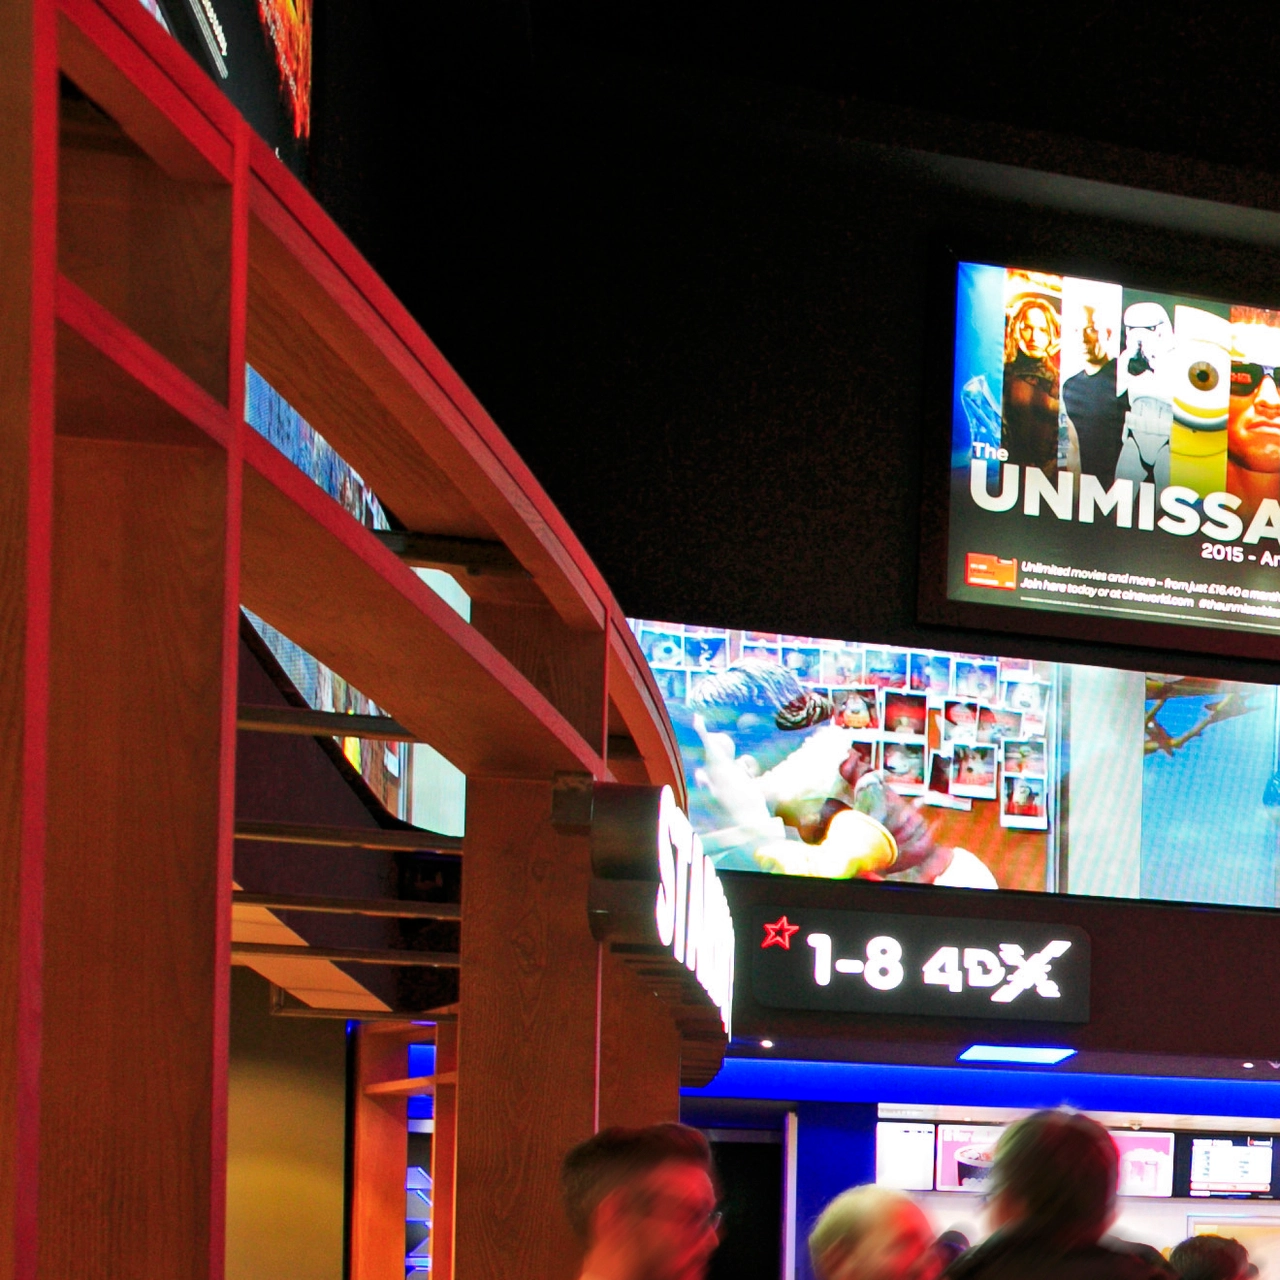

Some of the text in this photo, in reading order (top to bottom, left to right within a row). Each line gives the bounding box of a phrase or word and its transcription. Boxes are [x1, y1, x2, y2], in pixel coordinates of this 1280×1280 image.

[972, 441, 1008, 462] The
[1201, 543, 1243, 562] 2015
[1020, 578, 1042, 590] Join
[1043, 580, 1067, 593] here
[1067, 582, 1097, 598] today
[1097, 589, 1109, 597] or
[1021, 561, 1070, 577] Unlimited
[1071, 567, 1106, 581] movies
[1107, 571, 1129, 583] and
[1129, 575, 1156, 588] more
[1164, 578, 1188, 591] from
[1187, 581, 1208, 594] just
[807, 933, 1072, 1003] 1-8 4DX
